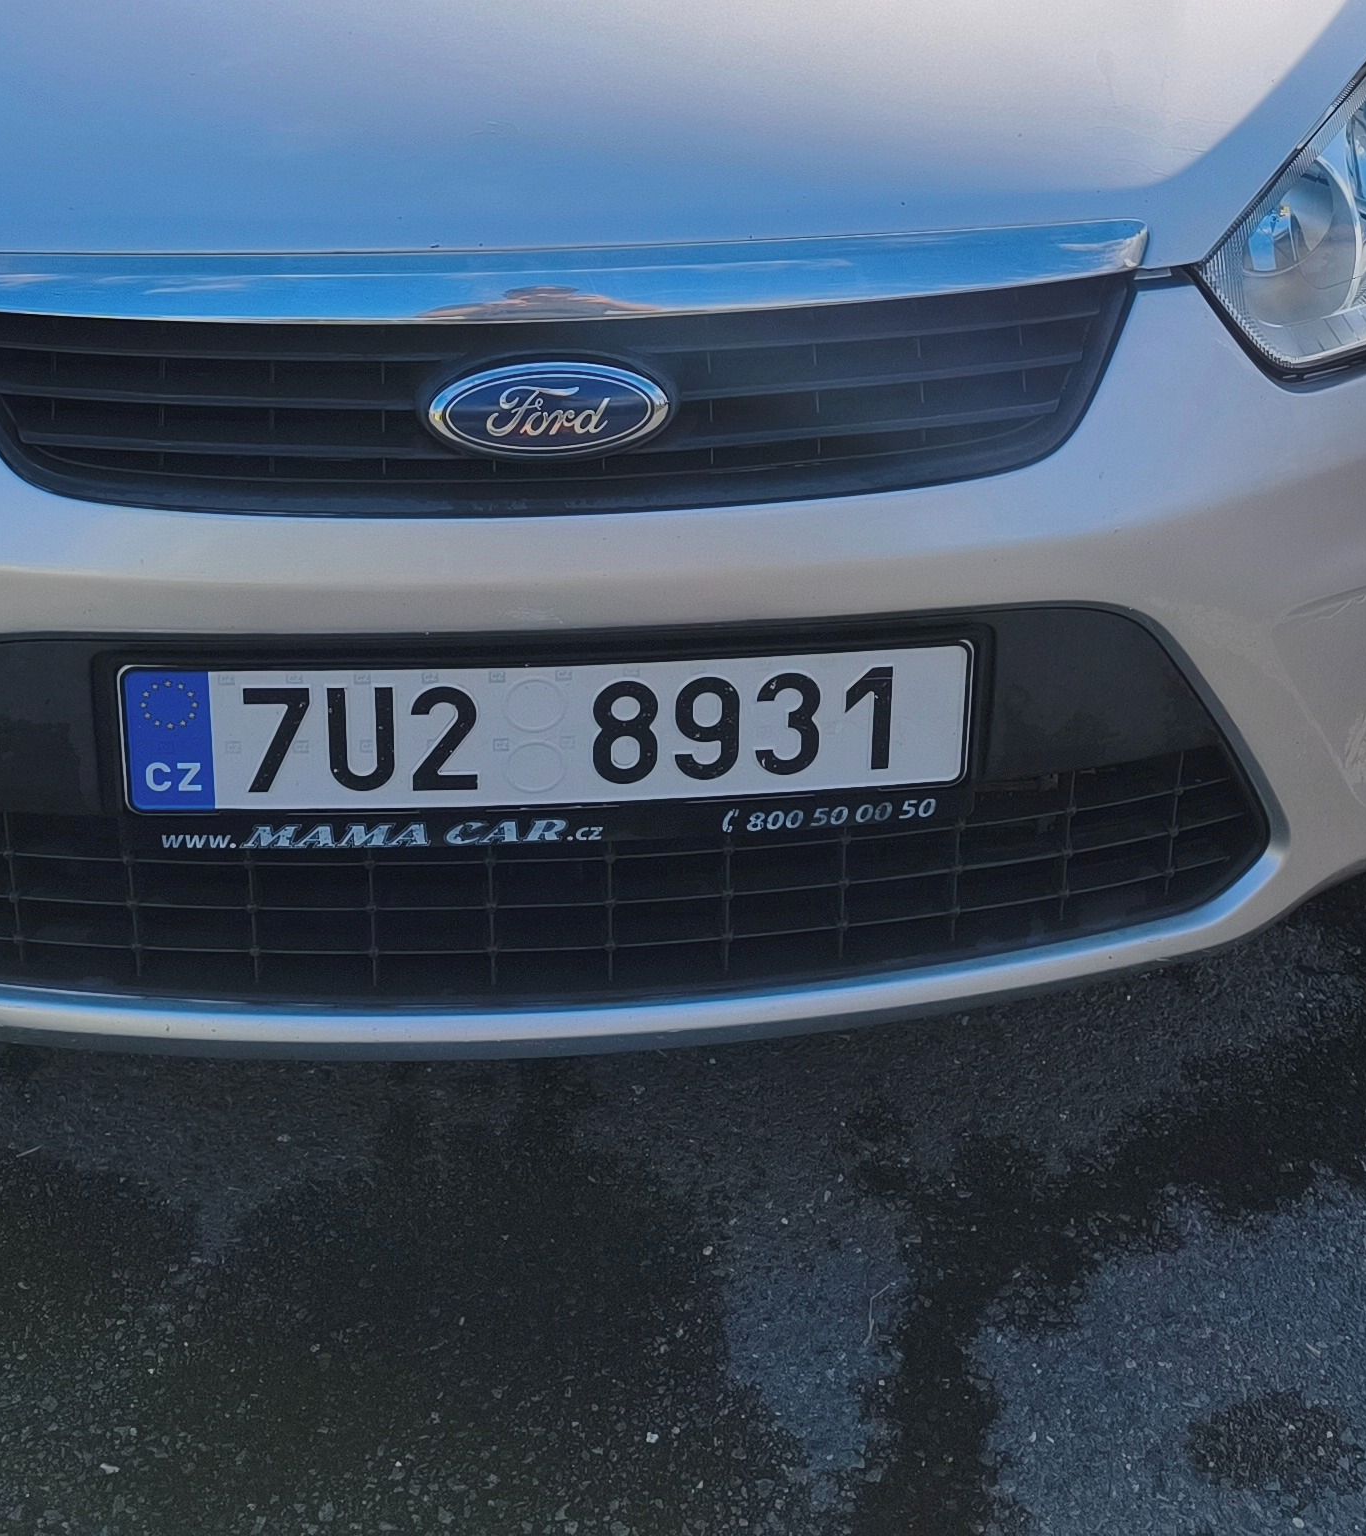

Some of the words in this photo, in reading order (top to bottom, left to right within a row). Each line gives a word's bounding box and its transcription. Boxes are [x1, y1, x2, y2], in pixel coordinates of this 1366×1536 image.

[486, 385, 611, 437] Ford
[242, 686, 478, 793] 7U2
[592, 666, 893, 785] 8931
[145, 762, 202, 792] CZ
[746, 810, 804, 831] 800
[810, 807, 848, 826] 50
[855, 802, 892, 822] 00
[898, 798, 936, 819] 50
